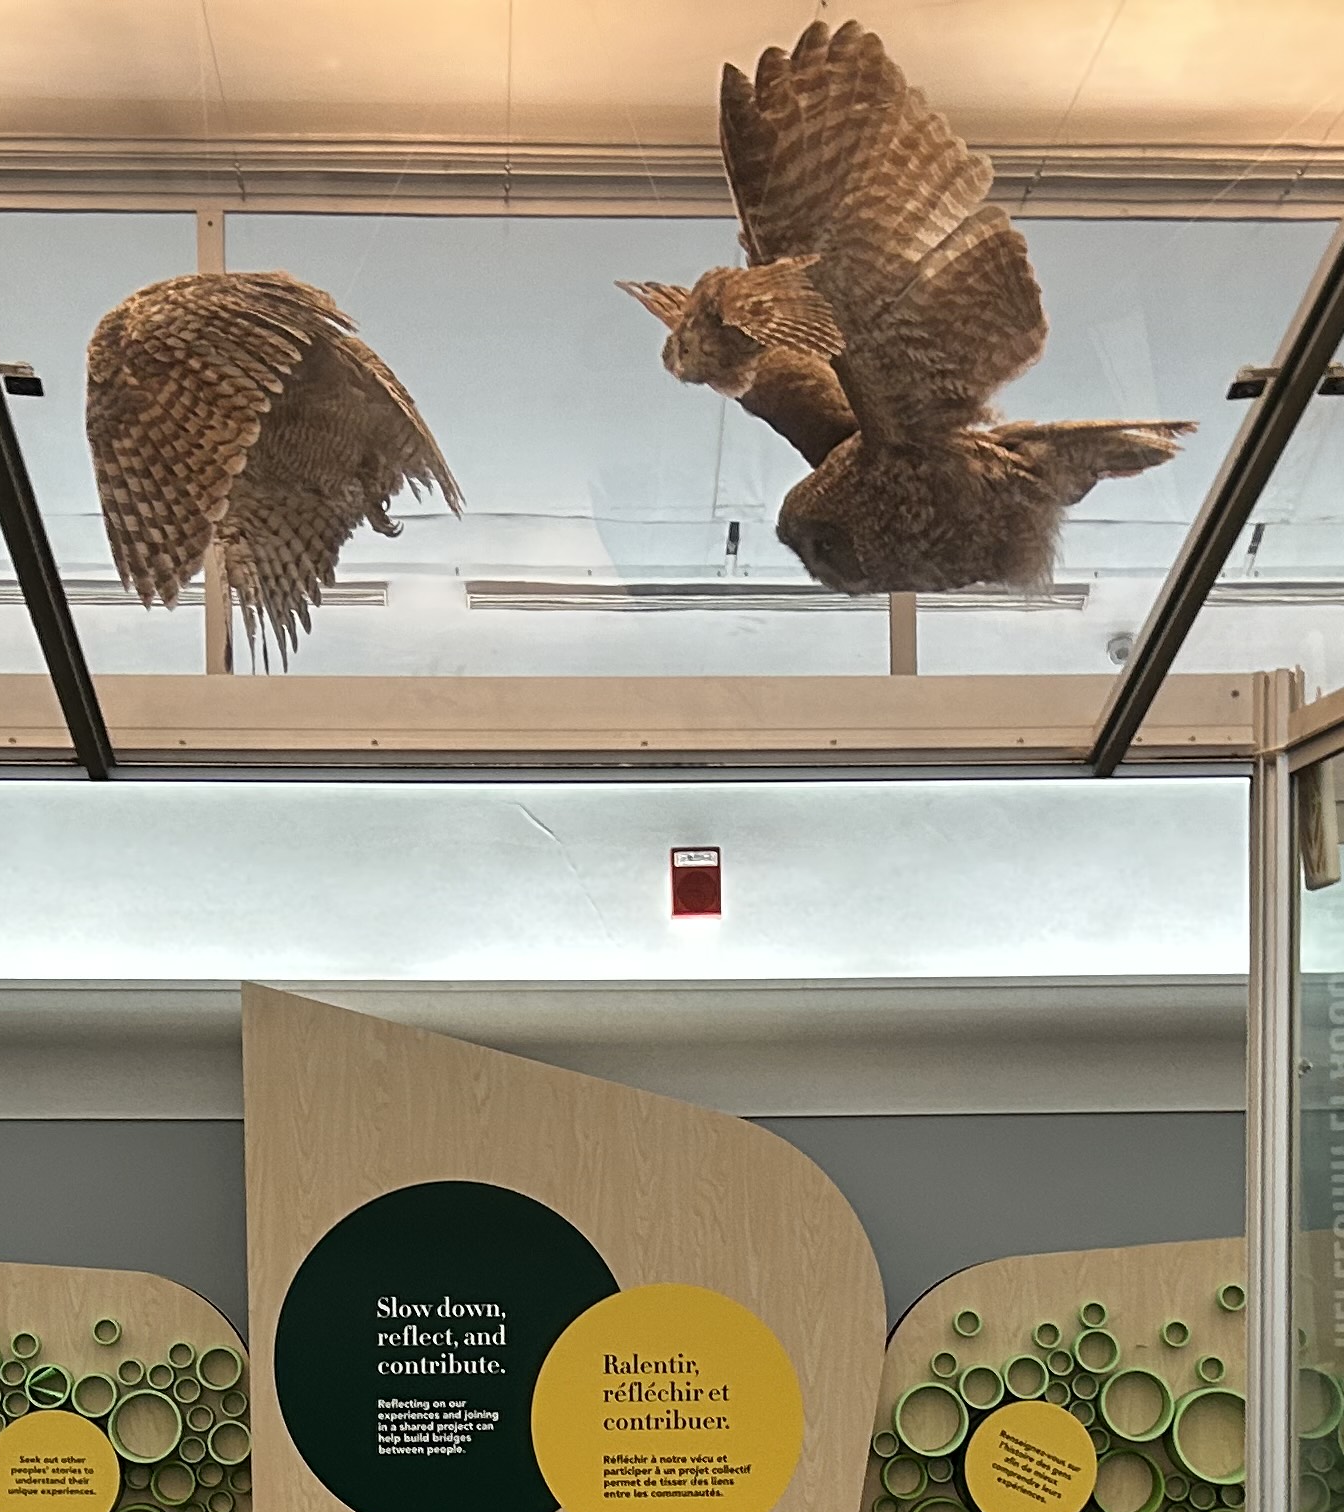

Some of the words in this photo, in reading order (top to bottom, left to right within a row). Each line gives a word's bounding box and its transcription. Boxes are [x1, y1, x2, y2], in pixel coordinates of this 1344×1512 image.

[376, 1296, 434, 1319] Slow
[437, 1296, 506, 1320] down,
[377, 1324, 459, 1349] reflect,
[463, 1324, 506, 1347] and
[377, 1352, 506, 1375] contribute.
[602, 1353, 700, 1377] Ralentir,
[602, 1381, 704, 1403] réfléchir
[708, 1384, 730, 1402] et
[377, 1398, 430, 1411] Reflecting
[432, 1400, 447, 1408] on
[448, 1400, 467, 1408] our
[377, 1409, 440, 1422] experiences
[442, 1409, 462, 1420] and
[463, 1409, 500, 1422] joining
[603, 1409, 730, 1431] contribuer.
[377, 1422, 388, 1432] in
[390, 1423, 397, 1431] a
[399, 1421, 434, 1432] shared
[436, 1421, 474, 1434] project
[476, 1423, 494, 1431] can
[378, 1432, 401, 1445] help
[403, 1432, 430, 1443] build
[432, 1432, 472, 1445] bridges
[378, 1444, 425, 1455] between
[426, 1443, 467, 1456] people.
[19, 1456, 41, 1464] Seek
[61, 1456, 86, 1464] other
[603, 1454, 649, 1464] Réfléchir
[650, 1454, 657, 1464] à
[659, 1455, 687, 1464] notre
[689, 1454, 714, 1463] vécu
[716, 1455, 728, 1463] et
[51, 1466, 81, 1474] stories
[603, 1465, 653, 1478] participer
[654, 1465, 661, 1475] à
[663, 1467, 676, 1475] un
[678, 1465, 710, 1477] projet
[711, 1464, 752, 1475] collectif
[15, 1476, 66, 1485] understand
[68, 1476, 90, 1485] their
[603, 1478, 641, 1489] permet
[643, 1476, 657, 1486] de
[659, 1477, 687, 1486] tisser
[690, 1476, 709, 1486] des
[710, 1476, 735, 1486] liens
[7, 1487, 38, 1496] unique
[40, 1486, 97, 1496] experiences.
[603, 1490, 631, 1498] entre
[633, 1488, 649, 1498] les
[650, 1488, 724, 1498] communautés.
